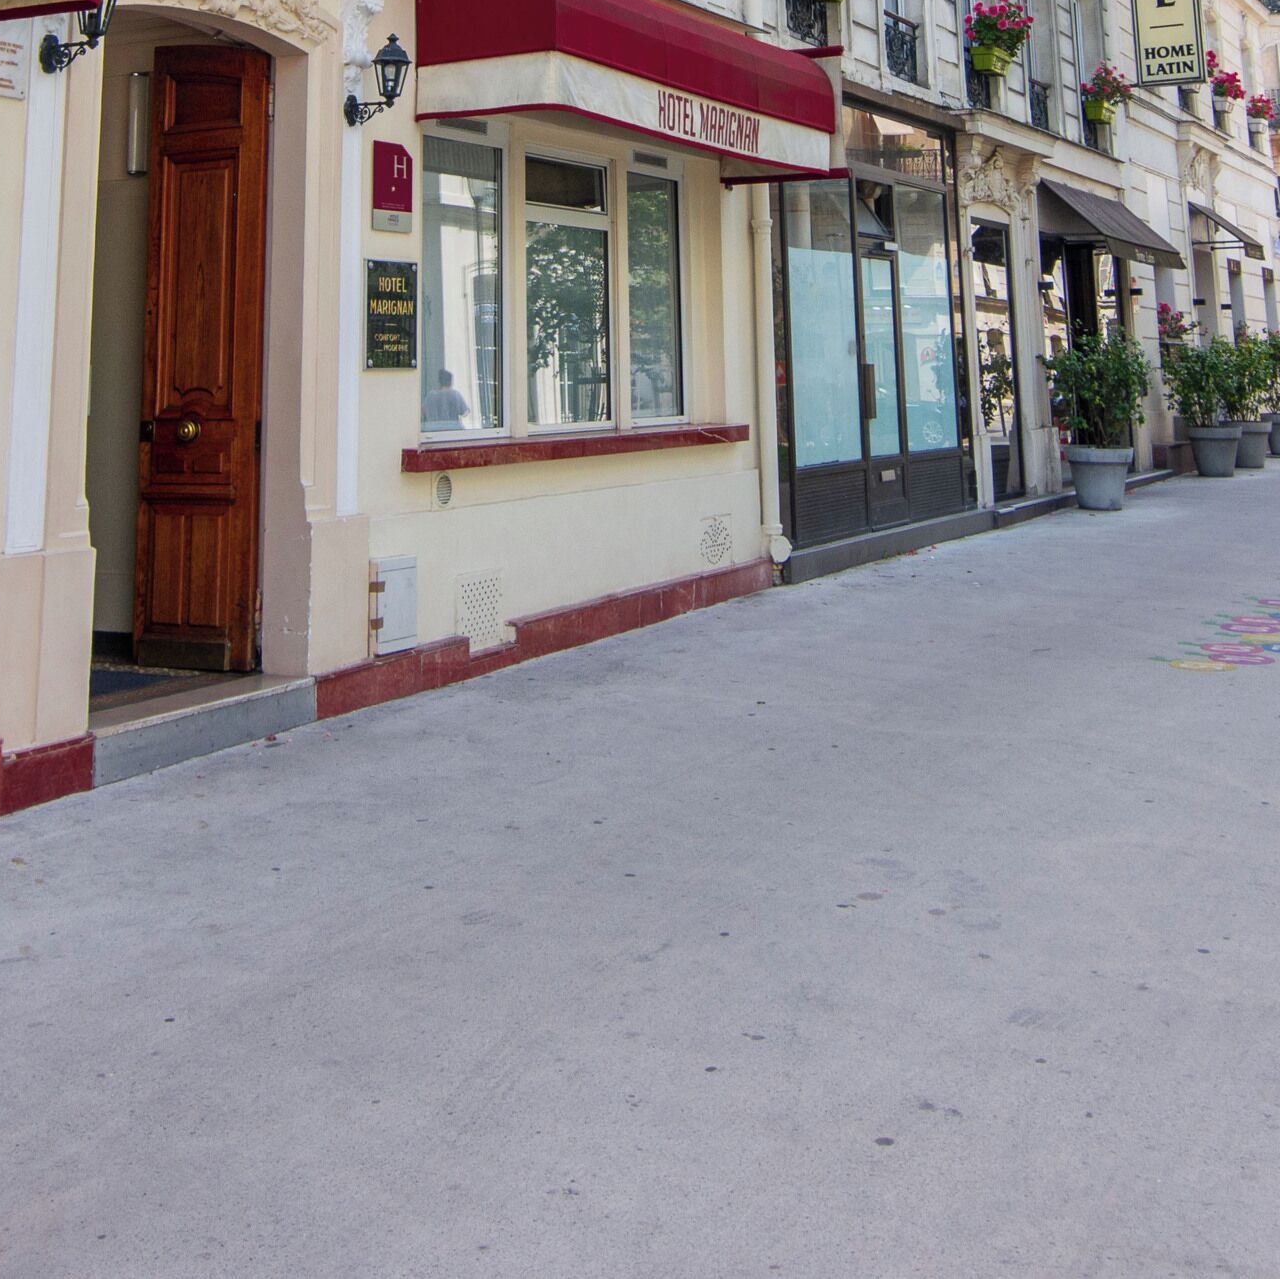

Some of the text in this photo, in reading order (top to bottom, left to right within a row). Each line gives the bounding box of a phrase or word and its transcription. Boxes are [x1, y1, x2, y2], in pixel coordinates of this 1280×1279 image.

[1144, 43, 1196, 60] HOME
[1146, 60, 1195, 77] LATIN
[658, 90, 760, 153] HOTEL MARIGNAN
[393, 154, 407, 179] H
[379, 277, 407, 292] HOTEL
[370, 299, 414, 316] MARIGNAN
